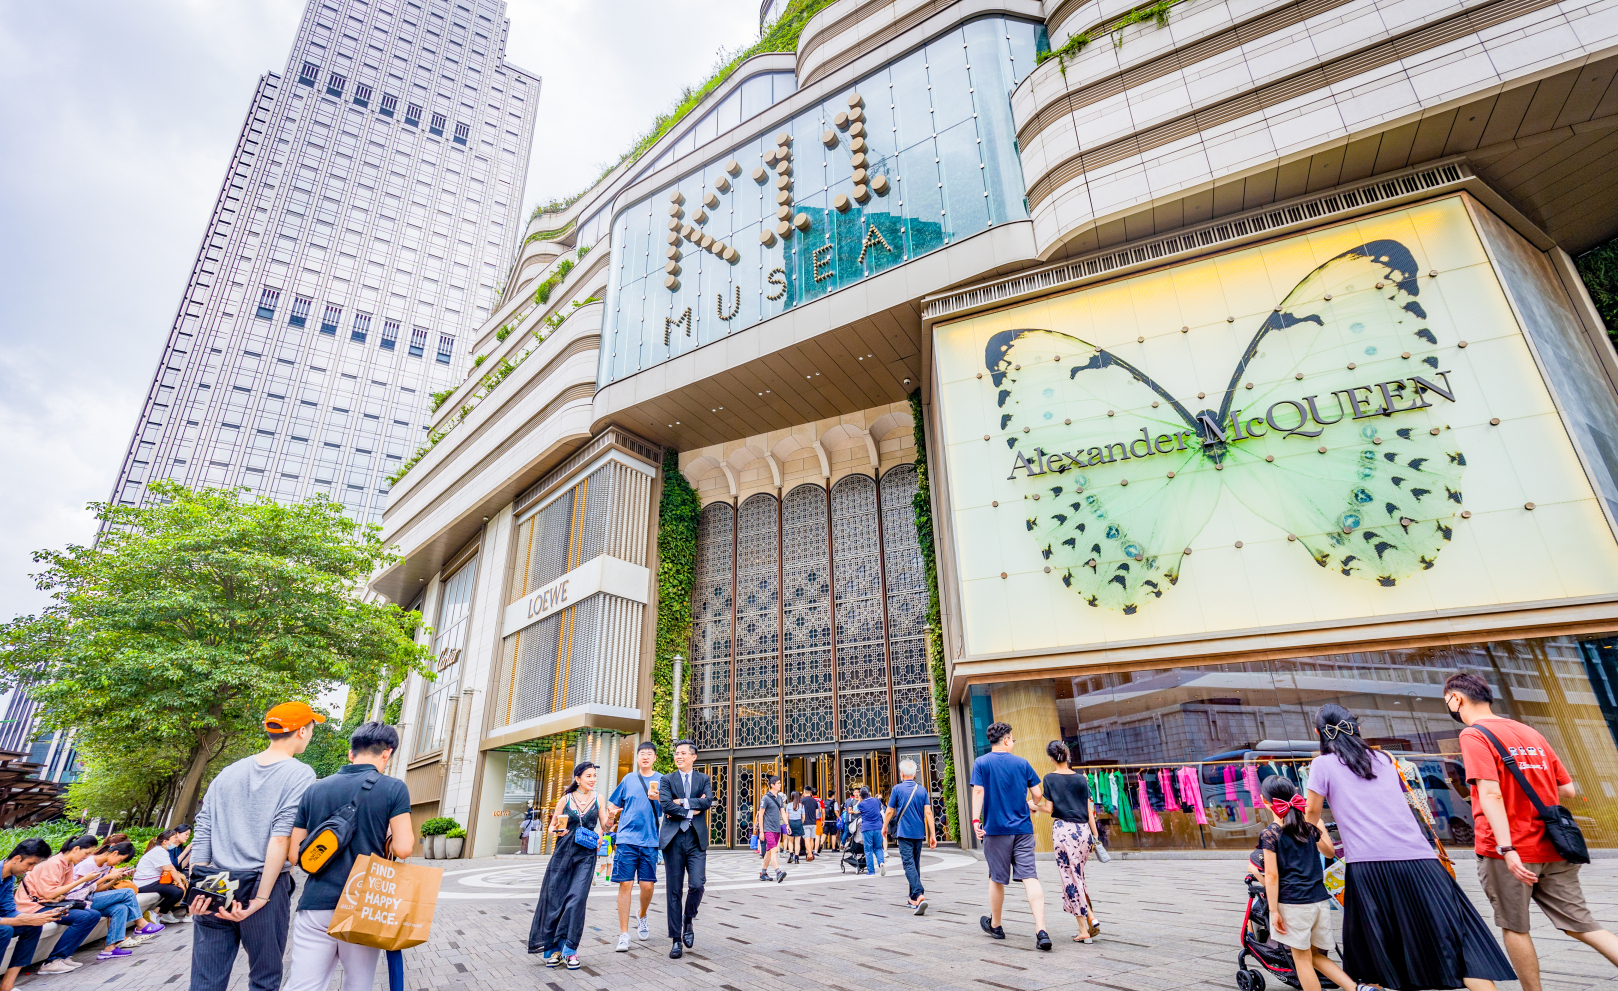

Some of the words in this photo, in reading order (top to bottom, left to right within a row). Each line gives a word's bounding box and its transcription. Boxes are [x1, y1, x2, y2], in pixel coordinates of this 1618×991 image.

[664, 92, 890, 292] K11
[663, 223, 892, 347] MUSEA
[1006, 426, 1191, 480] Alexander
[1197, 370, 1456, 440] McQUEEN
[527, 579, 569, 619] LOEWE
[436, 646, 462, 673] Cartier
[370, 861, 396, 879] FIND
[360, 906, 399, 926] PLACE.
[364, 891, 403, 910] HAPPY
